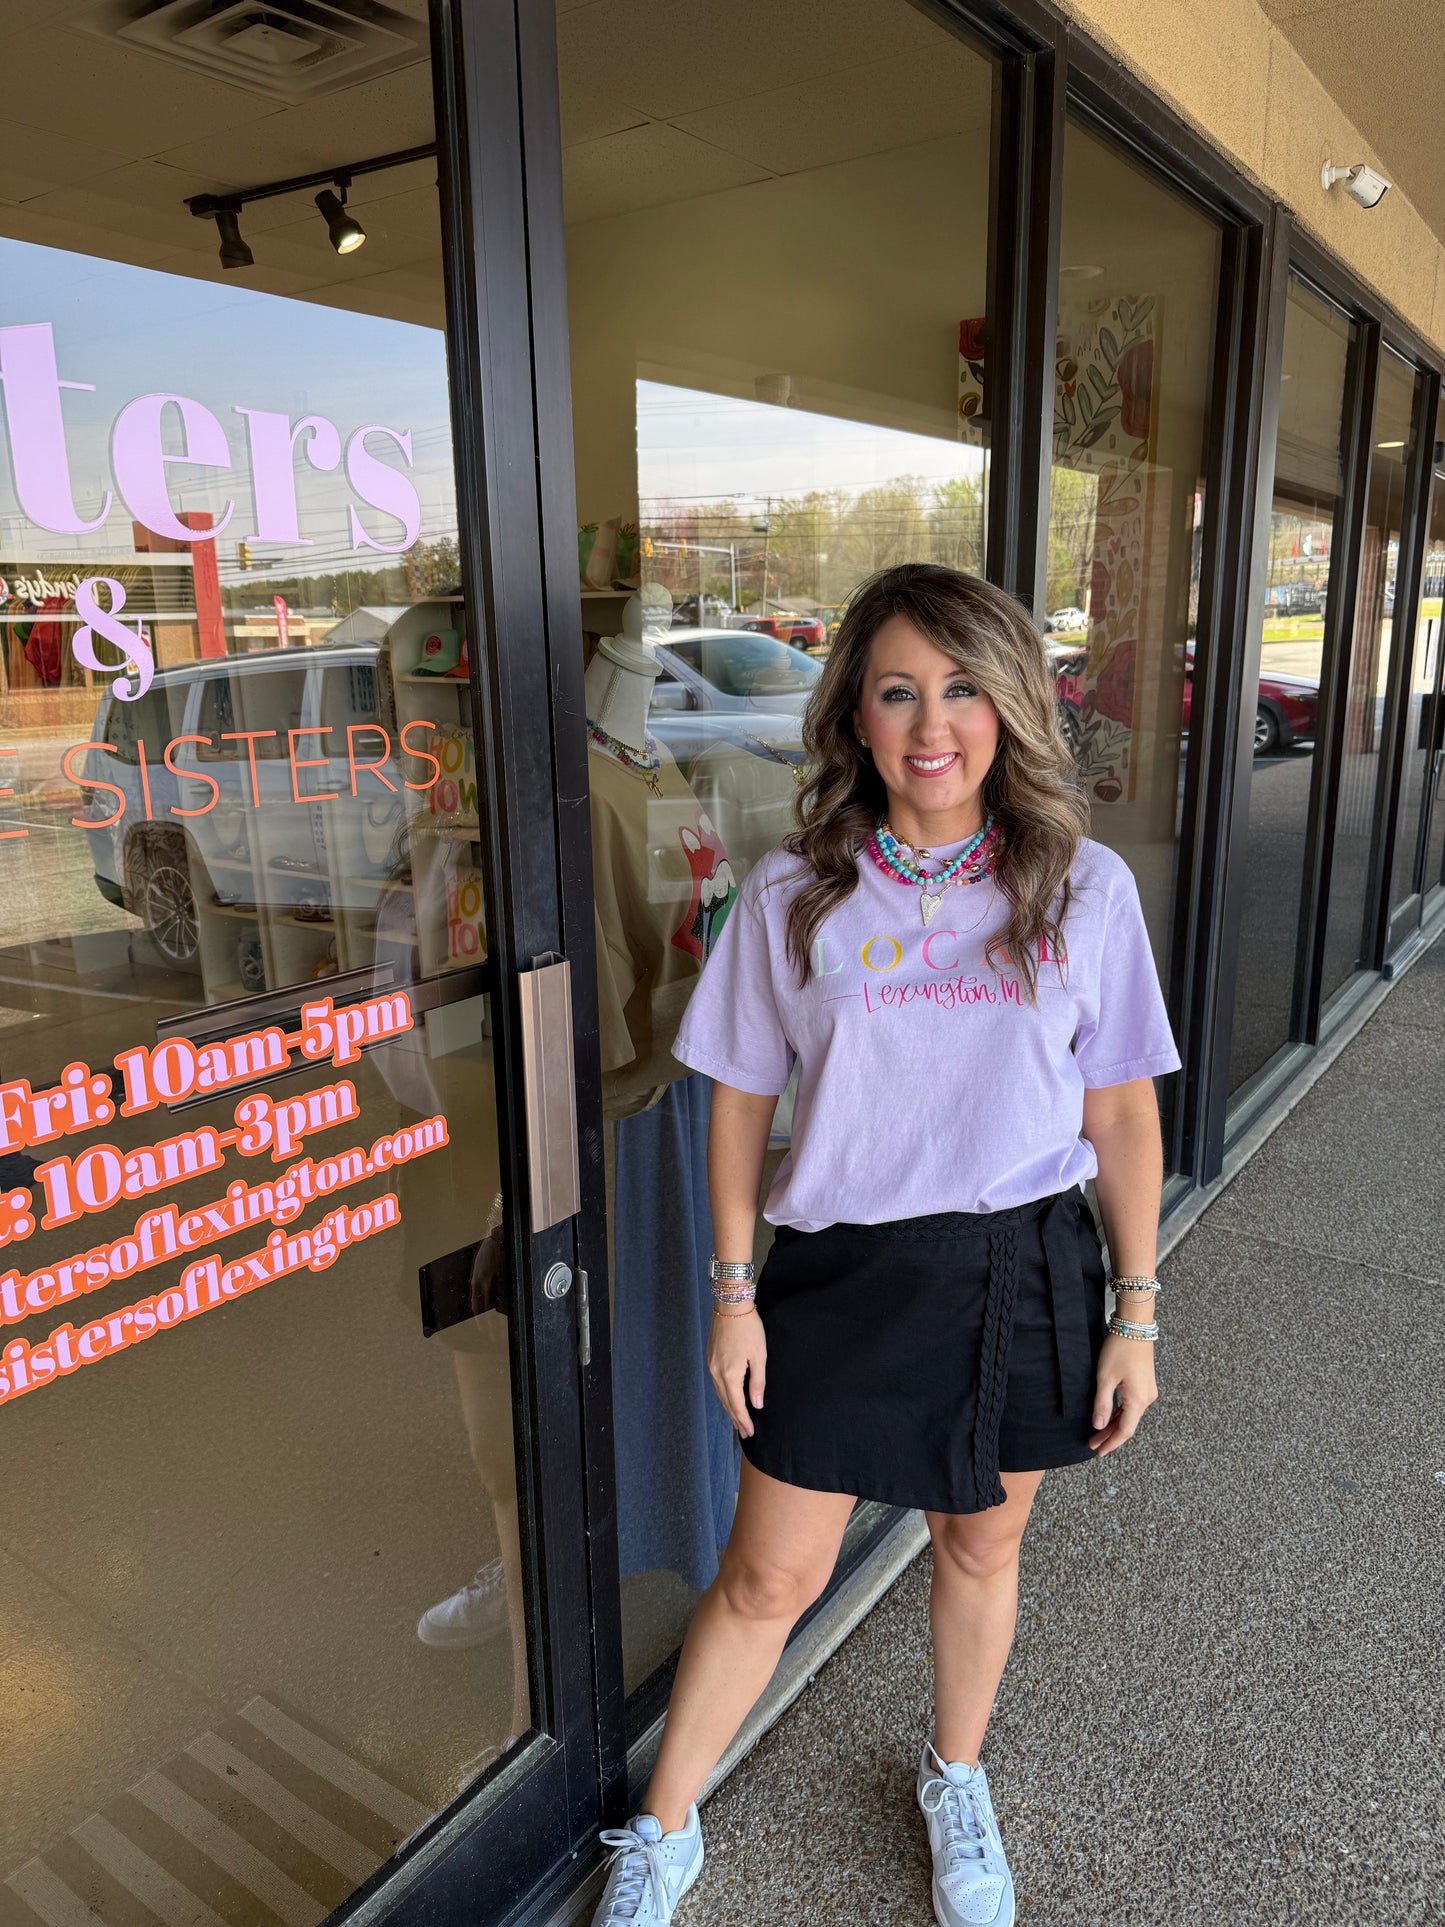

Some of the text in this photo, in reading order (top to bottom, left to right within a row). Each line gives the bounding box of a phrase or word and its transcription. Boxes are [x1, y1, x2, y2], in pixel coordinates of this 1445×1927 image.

[72, 576, 155, 702] &
[63, 719, 442, 830] SISTERS
[118, 993, 411, 1112] 10am-5pm
[40, 1084, 356, 1225] 10am-3pm
